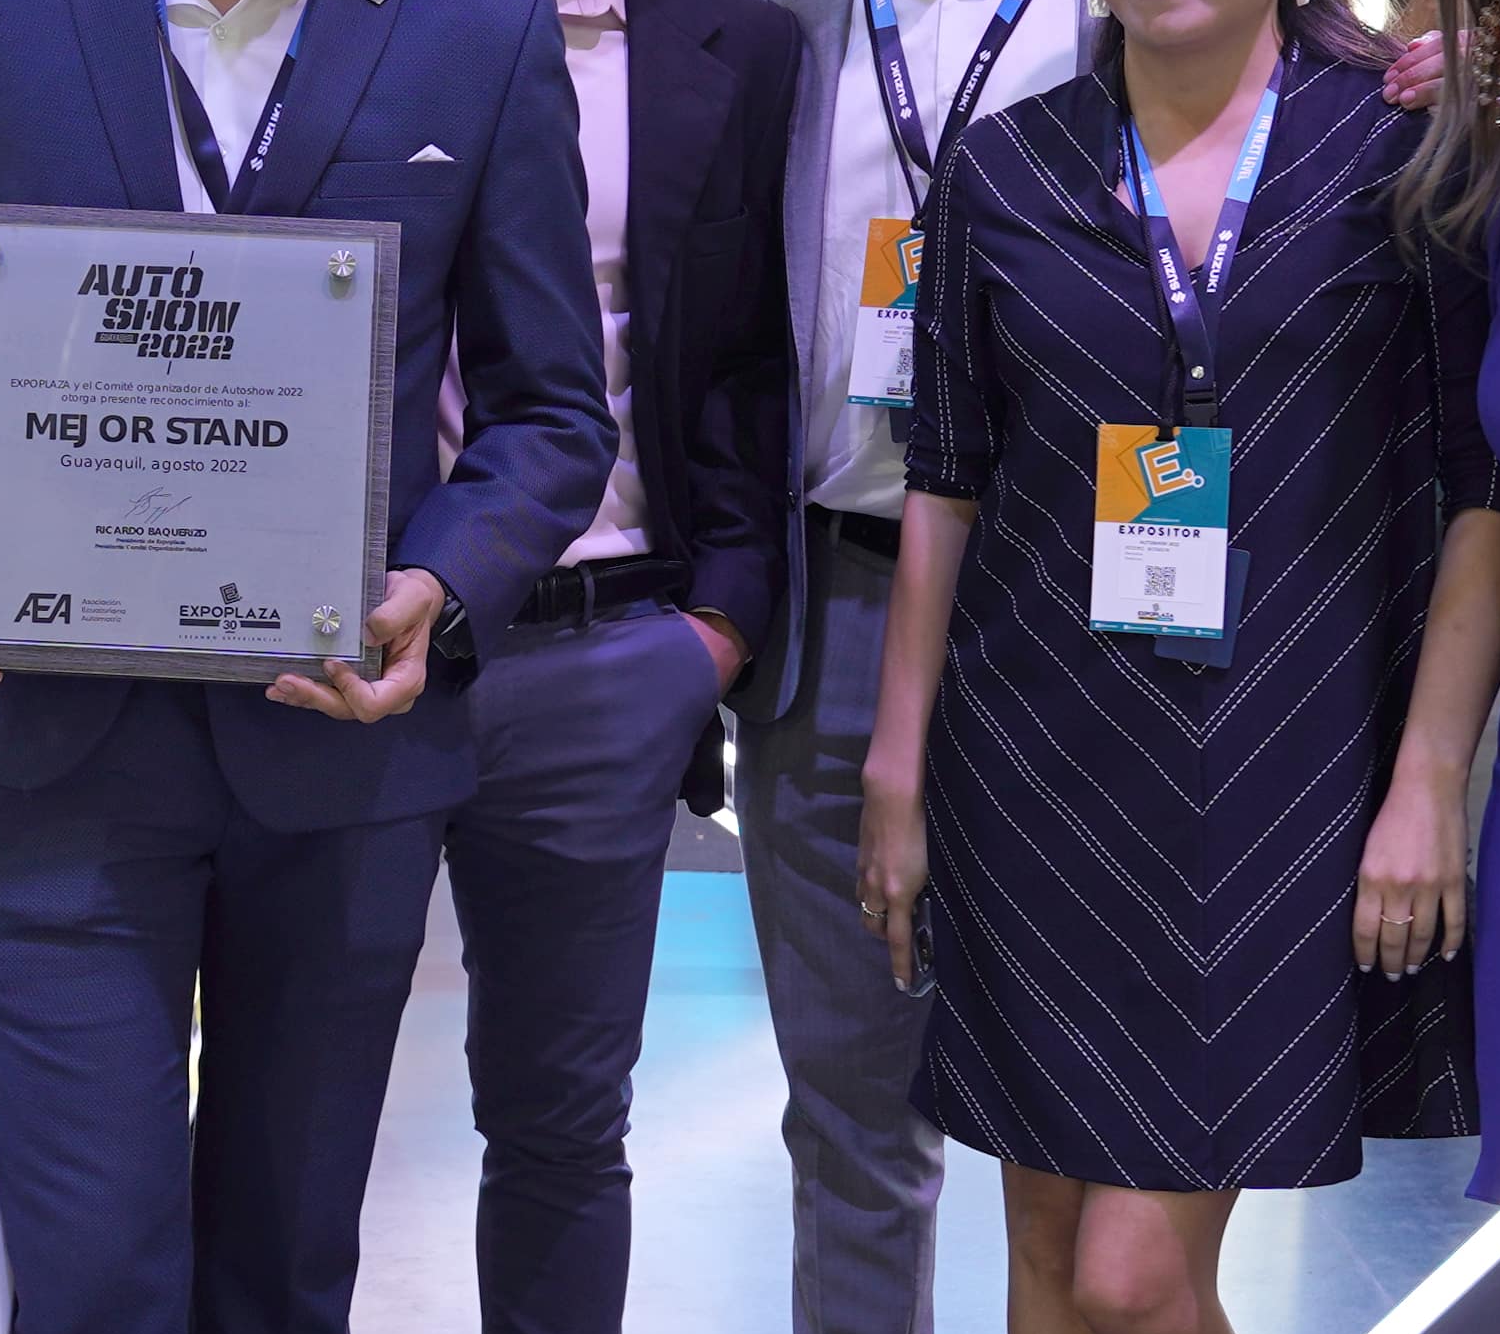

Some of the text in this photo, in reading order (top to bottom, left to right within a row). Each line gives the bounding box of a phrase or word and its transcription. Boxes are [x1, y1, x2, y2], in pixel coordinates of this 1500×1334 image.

[890, 60, 907, 107] SUZUKI
[957, 63, 984, 112] SUZUKI
[257, 103, 282, 156] SUZUKI
[78, 264, 204, 298] AUTO
[1159, 248, 1181, 292] SUZUKI
[1206, 243, 1228, 294] SUZUKI
[102, 298, 241, 333] SHOW
[137, 333, 235, 360] 2022
[10, 378, 70, 390] EXPOPLAZA
[82, 381, 92, 391] el
[96, 380, 134, 392] Comité
[136, 382, 202, 395] organizador
[204, 383, 219, 395] de
[221, 385, 275, 396] Autoshow
[278, 386, 304, 397] 2022
[61, 393, 251, 408] otorga presente reconocimiento al:
[166, 417, 289, 447] STAND
[60, 454, 248, 473] Guayaquil, agosto 2022
[95, 525, 208, 538] RICARDO BAQUERIZO
[1118, 525, 1201, 538] EXPOSITOR
[179, 604, 281, 620] EXPOPLAZA
[222, 620, 238, 630] 30
